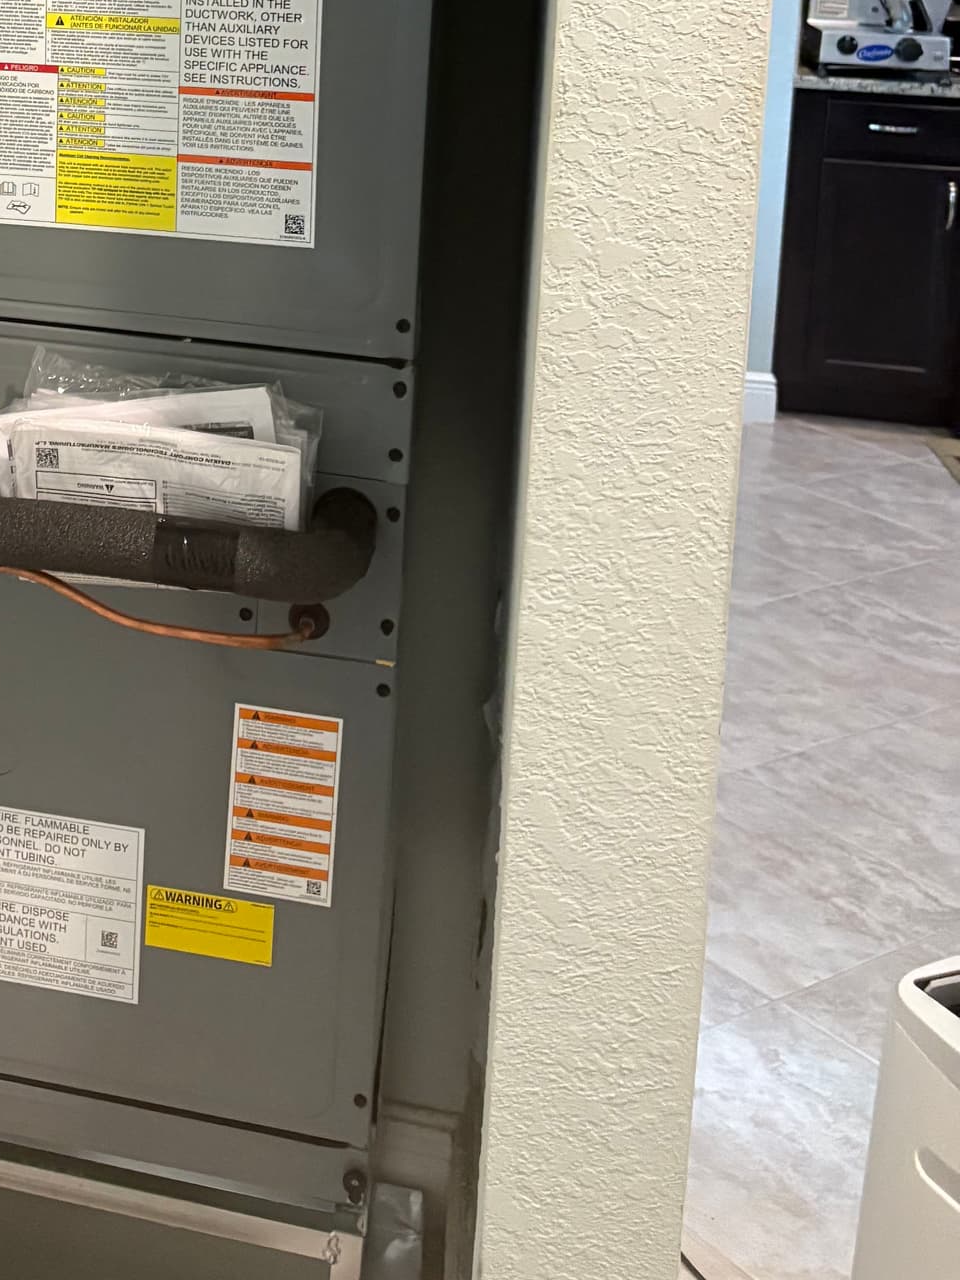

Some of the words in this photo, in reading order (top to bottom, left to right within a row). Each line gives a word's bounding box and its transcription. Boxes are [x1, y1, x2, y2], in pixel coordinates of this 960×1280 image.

[267, 0, 290, 9] THE
[186, 9, 258, 22] DUCTWORK,
[261, 12, 302, 22] OTHER
[186, 22, 217, 32] THAN
[220, 23, 280, 34] AUXILIARY
[185, 35, 236, 46] DEVICES
[239, 37, 280, 48] LISTED
[283, 39, 308, 49] FOR
[185, 48, 209, 58] USE
[212, 49, 242, 59] WITH
[245, 50, 268, 60] THE
[184, 61, 238, 72] SPECIFIC
[241, 63, 309, 75] APPLIANCE.
[184, 73, 207, 83] SEE
[210, 74, 300, 88] INSTRUCTIONS.
[112, 445, 168, 456] TECHNOLOGIES
[170, 452, 204, 462] COMFORT
[205, 457, 231, 465] DAIKIN
[77, 482, 104, 490] WARNING
[25, 817, 90, 835] FLAMMABLE
[7, 825, 21, 835] BE
[24, 828, 79, 844] REPAIRED
[82, 837, 111, 850] ONLY
[114, 843, 128, 852] BY
[45, 843, 61, 854] DO
[64, 847, 86, 858] NOT
[15, 850, 57, 866] TUBING.
[165, 891, 222, 910] WARNING
[22, 905, 70, 921] DISPOSE
[39, 920, 66, 933] WITH
[18, 941, 49, 954] USED.
